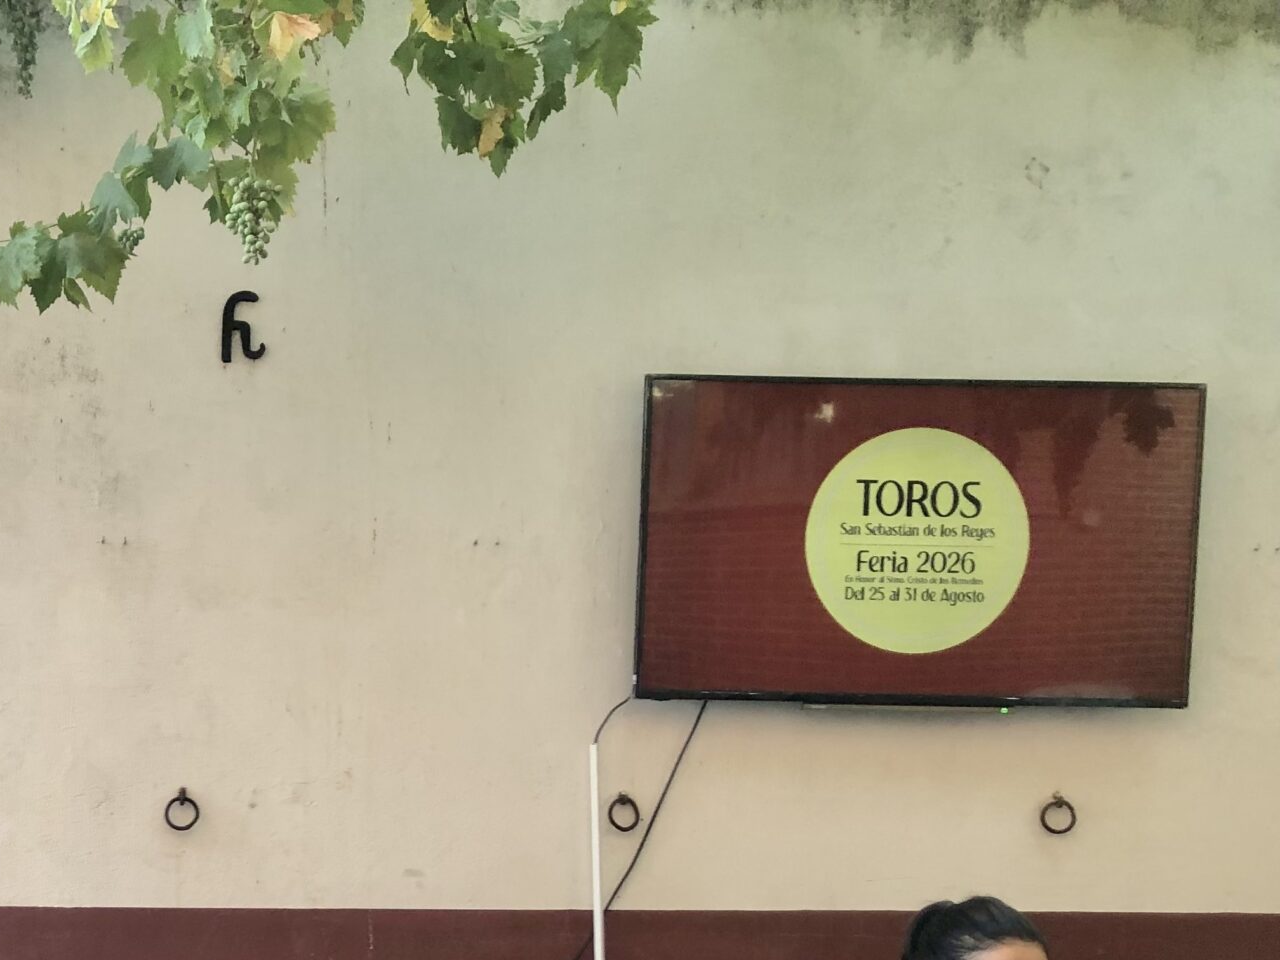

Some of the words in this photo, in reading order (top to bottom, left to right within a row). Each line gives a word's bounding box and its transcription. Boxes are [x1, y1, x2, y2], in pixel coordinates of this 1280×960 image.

[856, 479, 982, 519] TOROS
[840, 522, 861, 536] San
[923, 524, 936, 537] de
[940, 524, 958, 538] los
[961, 525, 995, 541] Reyes
[856, 550, 908, 573] Feria
[916, 551, 976, 574] 2026
[845, 586, 865, 600] Del
[869, 586, 885, 601] 25
[889, 587, 900, 601] al
[904, 587, 917, 601] 31
[921, 588, 936, 602] de
[940, 588, 985, 606] Agosto
